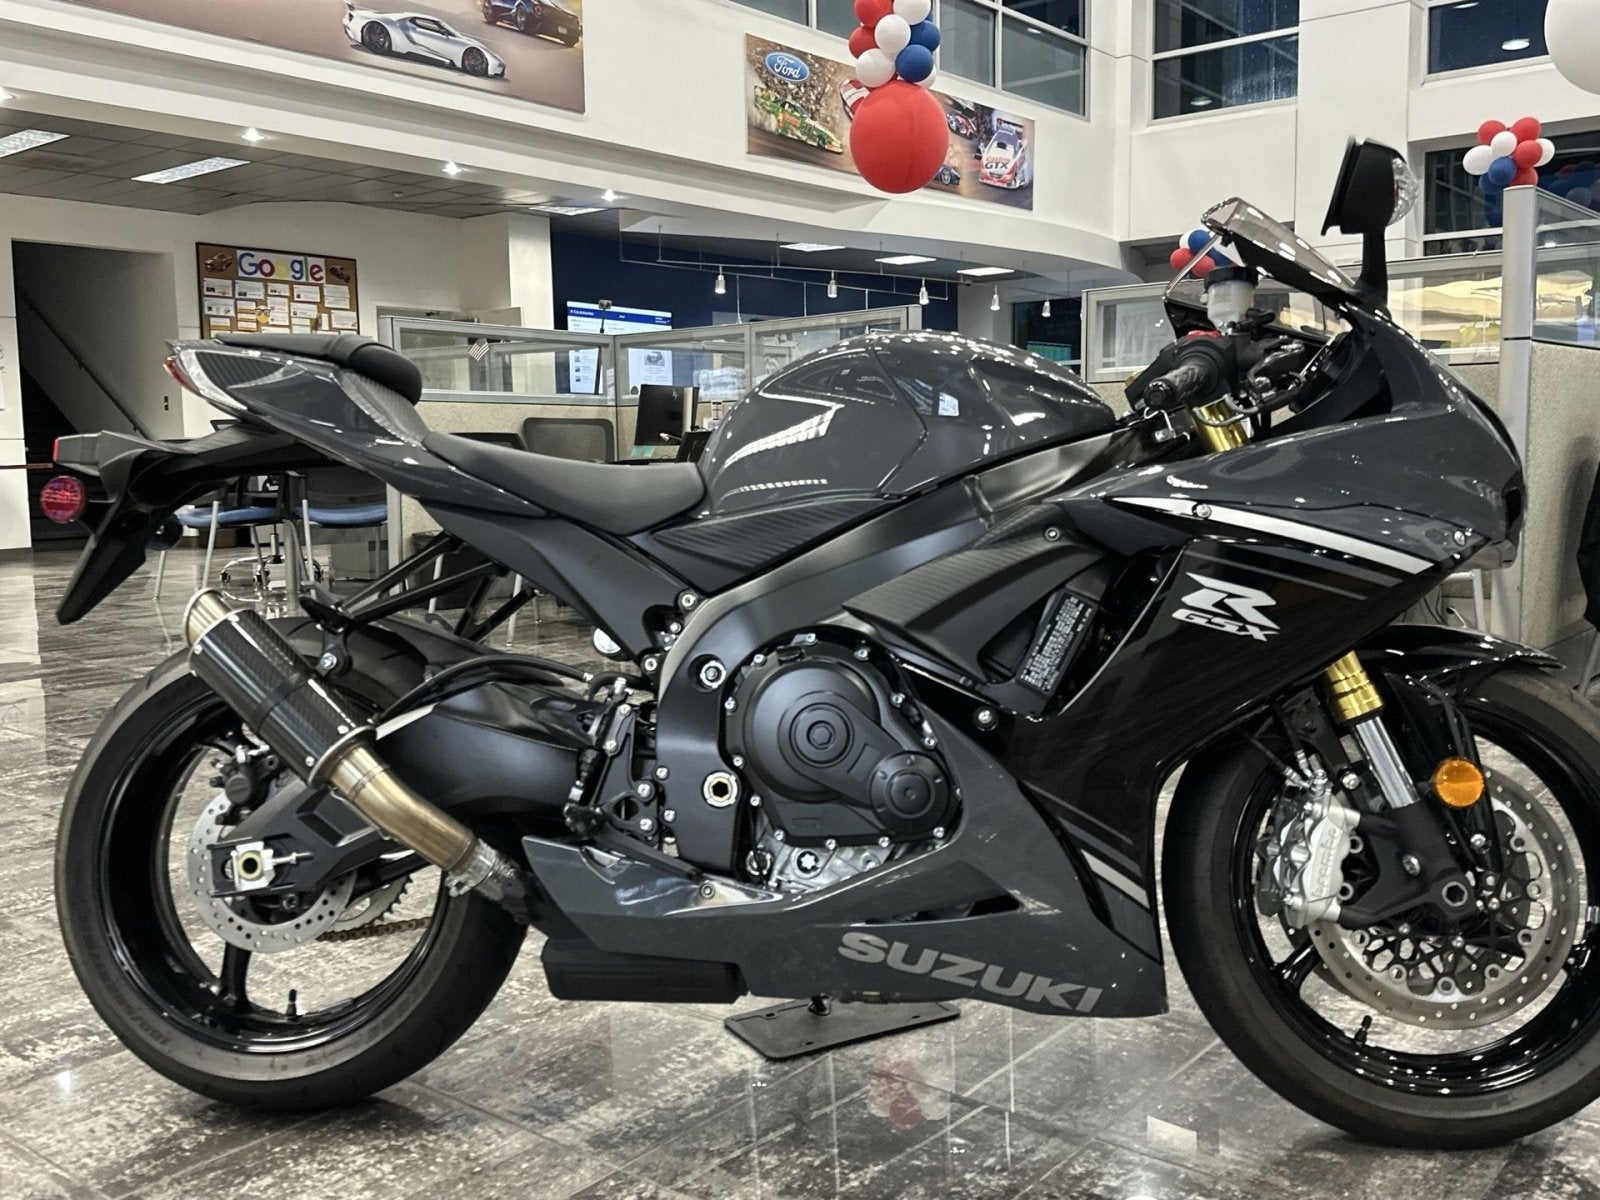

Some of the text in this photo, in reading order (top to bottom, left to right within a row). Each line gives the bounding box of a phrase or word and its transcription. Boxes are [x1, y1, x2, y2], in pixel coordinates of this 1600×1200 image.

[774, 55, 801, 79] Ford
[238, 252, 324, 281] Google
[1172, 608, 1280, 641] GSX
[838, 932, 1103, 1013] SUZUKI
